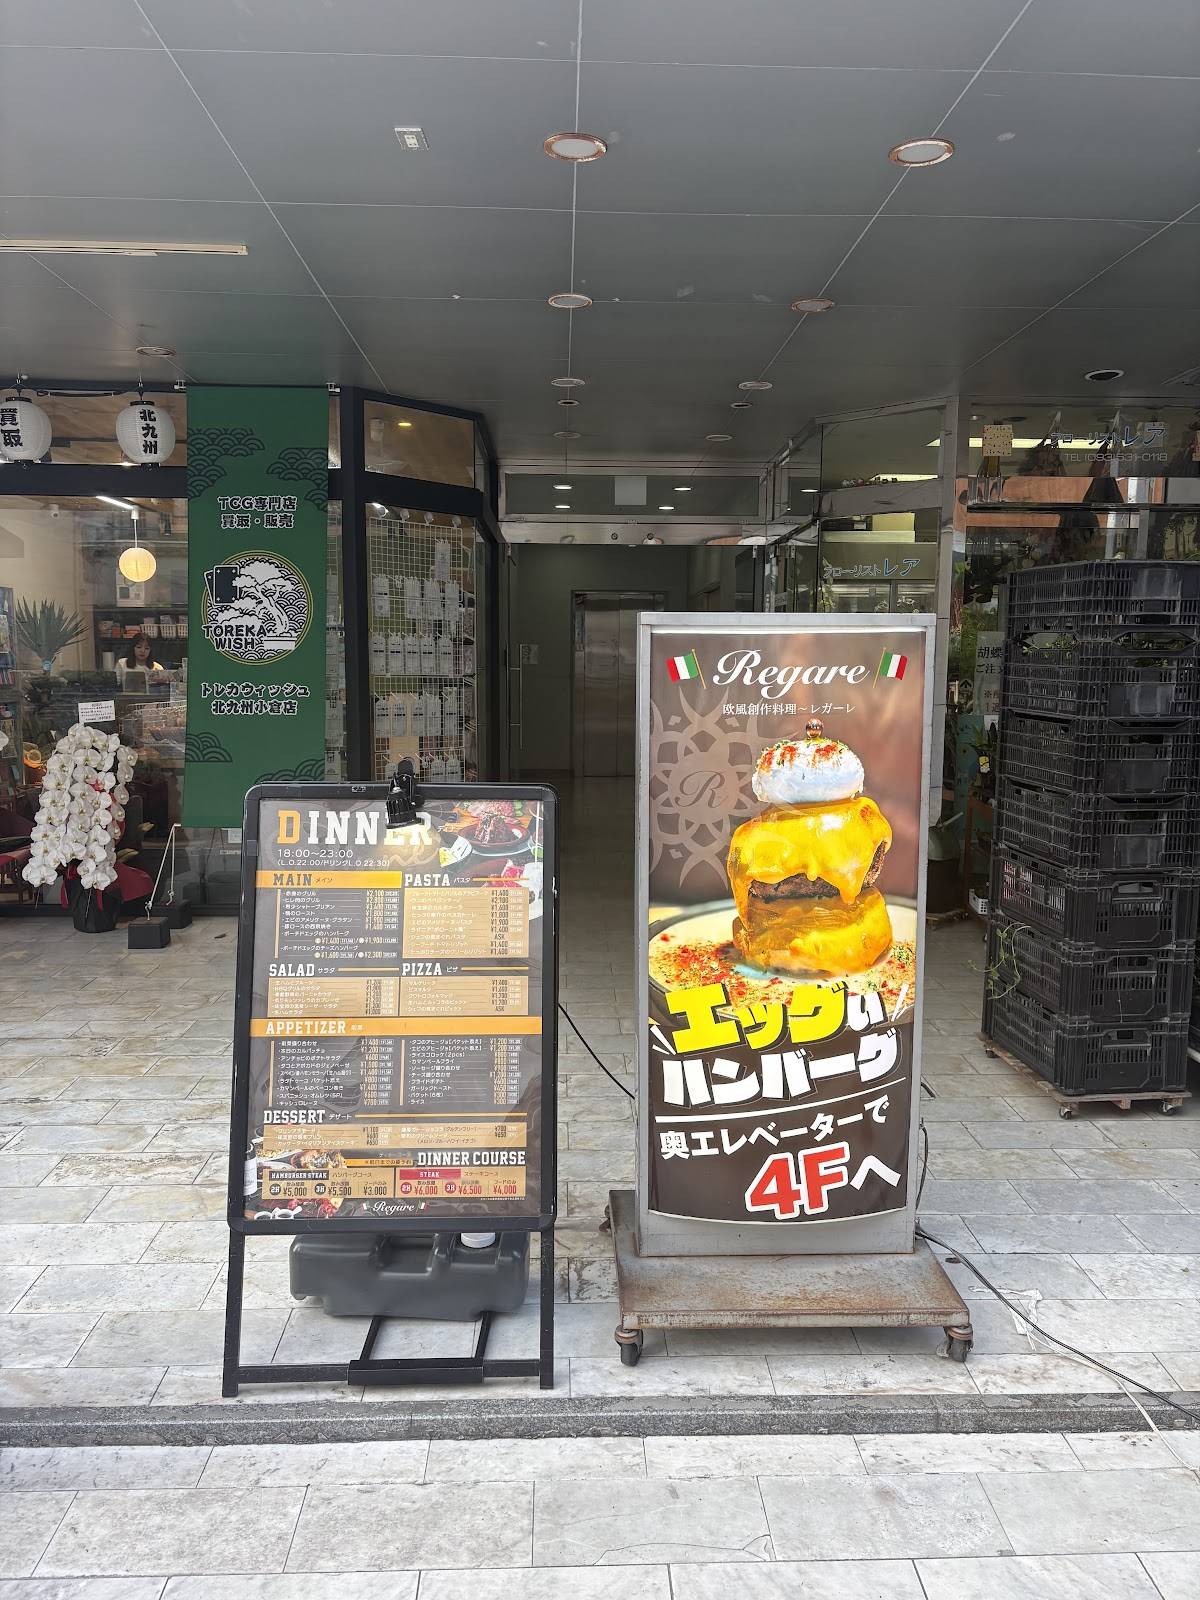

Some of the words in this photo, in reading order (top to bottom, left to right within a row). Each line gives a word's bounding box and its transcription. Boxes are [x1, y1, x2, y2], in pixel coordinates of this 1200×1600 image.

[139, 409, 157, 455] 北九州
[1064, 454, 1081, 462] TEL
[218, 496, 297, 511] TCG専門店
[220, 514, 294, 528] 買取・販売
[202, 624, 267, 637] TOREKA
[214, 637, 255, 650] WISH
[712, 649, 870, 700] Regare
[200, 682, 310, 697] トレカウィッシュ
[211, 700, 298, 715] 北九州小倉店
[273, 874, 312, 886] MAIN
[404, 874, 450, 887] PASTA
[269, 964, 315, 976] SALAD
[402, 963, 442, 976] PIZZA
[665, 981, 885, 1053] エッグい
[266, 1021, 346, 1035] APPETIZER
[662, 1028, 898, 1105] ハンバーグ
[264, 1110, 325, 1123] DESSERT
[659, 1094, 890, 1160] 奥エレベーターで
[418, 1152, 469, 1165] DINNER
[473, 1151, 525, 1165] COURSE
[745, 1141, 901, 1219] 4Fへ
[283, 1187, 307, 1196] ¥5,000
[328, 1187, 351, 1196] ¥5,500
[364, 1187, 387, 1195] ¥3,000
[415, 1185, 437, 1195] ¥6,000
[459, 1185, 481, 1194] ¥6,500
[493, 1185, 516, 1194] ¥4,000
[372, 1201, 415, 1215] Regare
